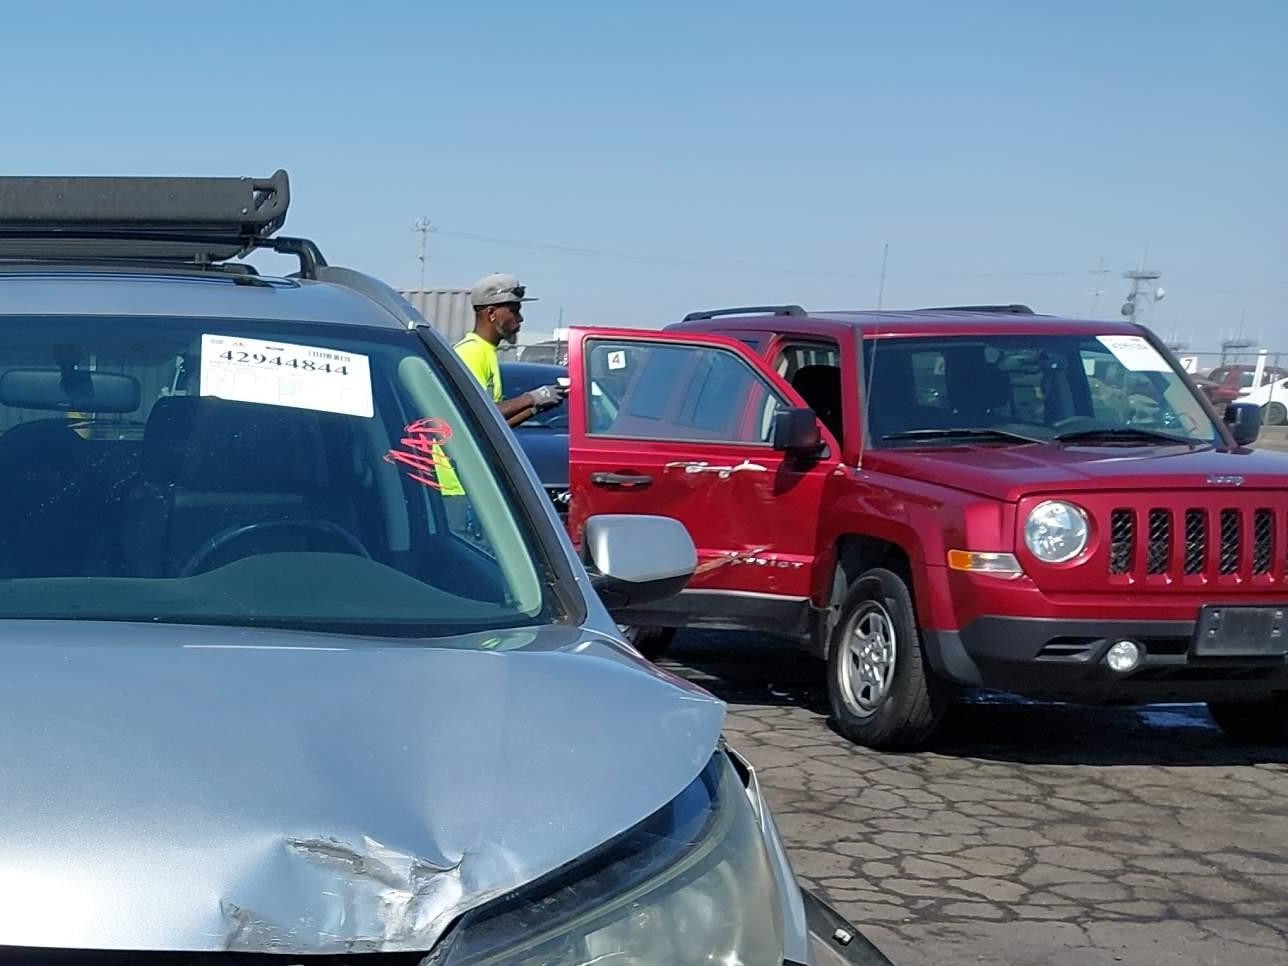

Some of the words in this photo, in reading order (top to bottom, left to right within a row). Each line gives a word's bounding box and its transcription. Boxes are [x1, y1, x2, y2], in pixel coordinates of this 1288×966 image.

[219, 350, 349, 376] 42944844
[612, 352, 620, 365] 4
[1185, 358, 1193, 371] 7
